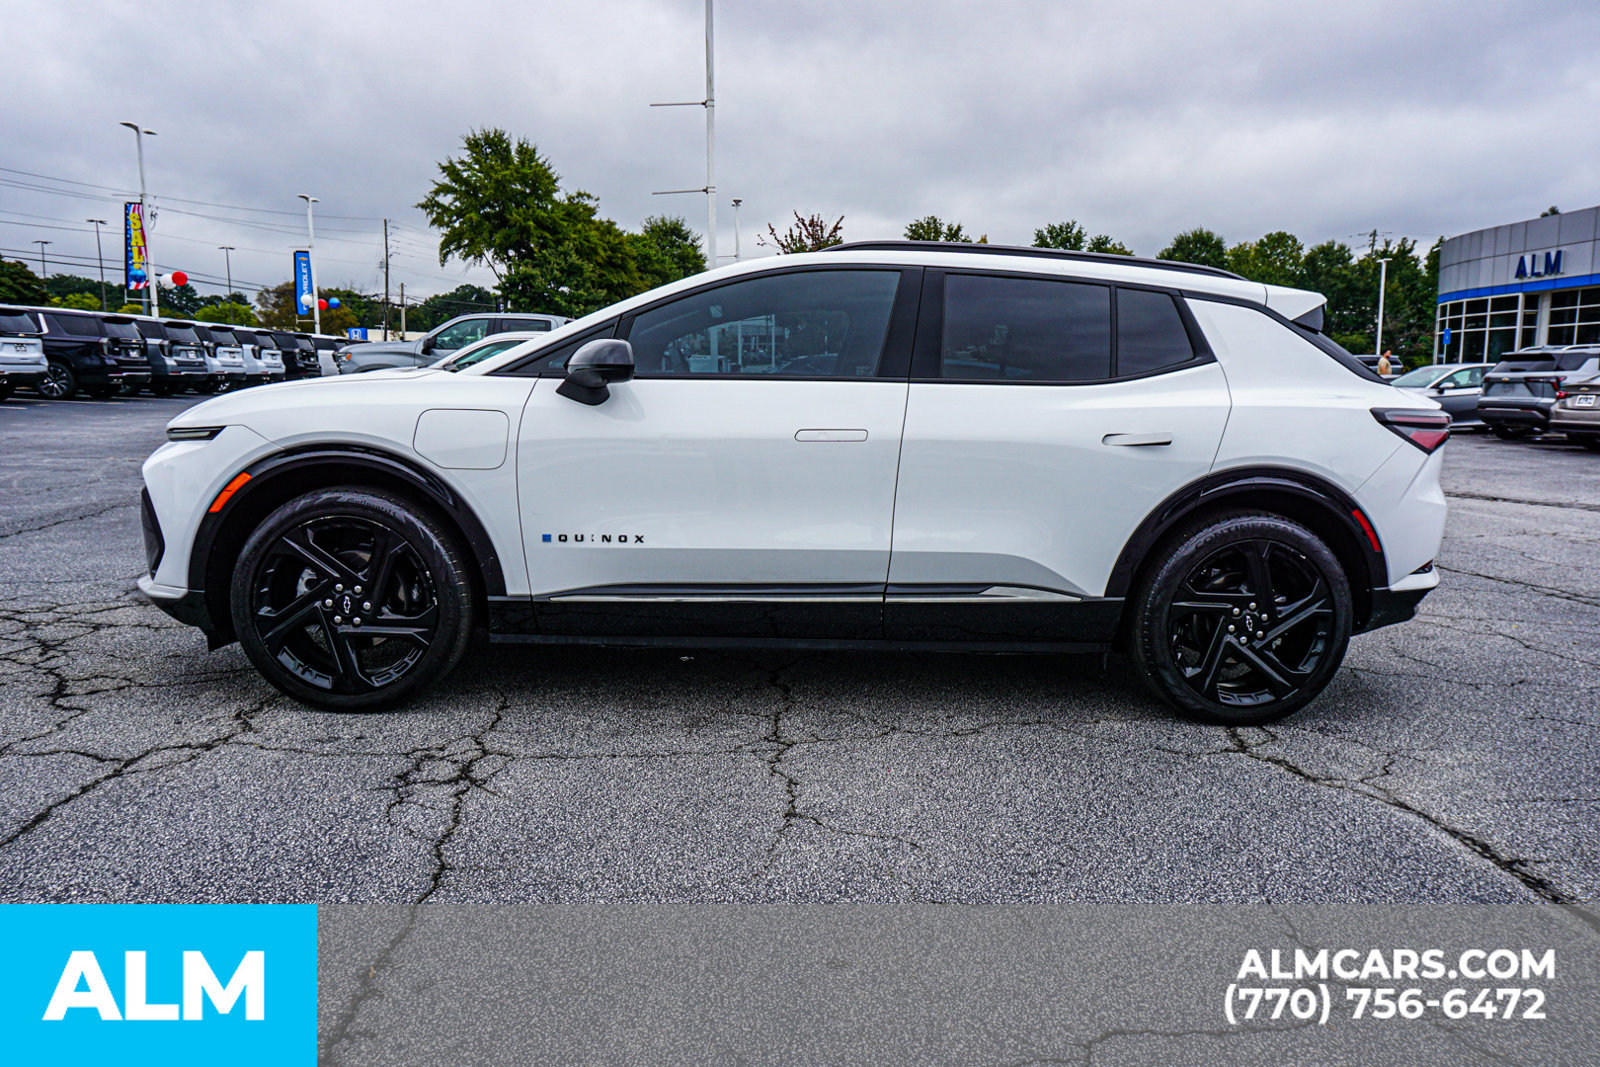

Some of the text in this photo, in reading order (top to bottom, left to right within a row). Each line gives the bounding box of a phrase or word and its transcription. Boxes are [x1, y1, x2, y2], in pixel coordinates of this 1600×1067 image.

[128, 212, 145, 270] SAL
[1515, 250, 1562, 279] ALM
[301, 261, 309, 311] CVROLET
